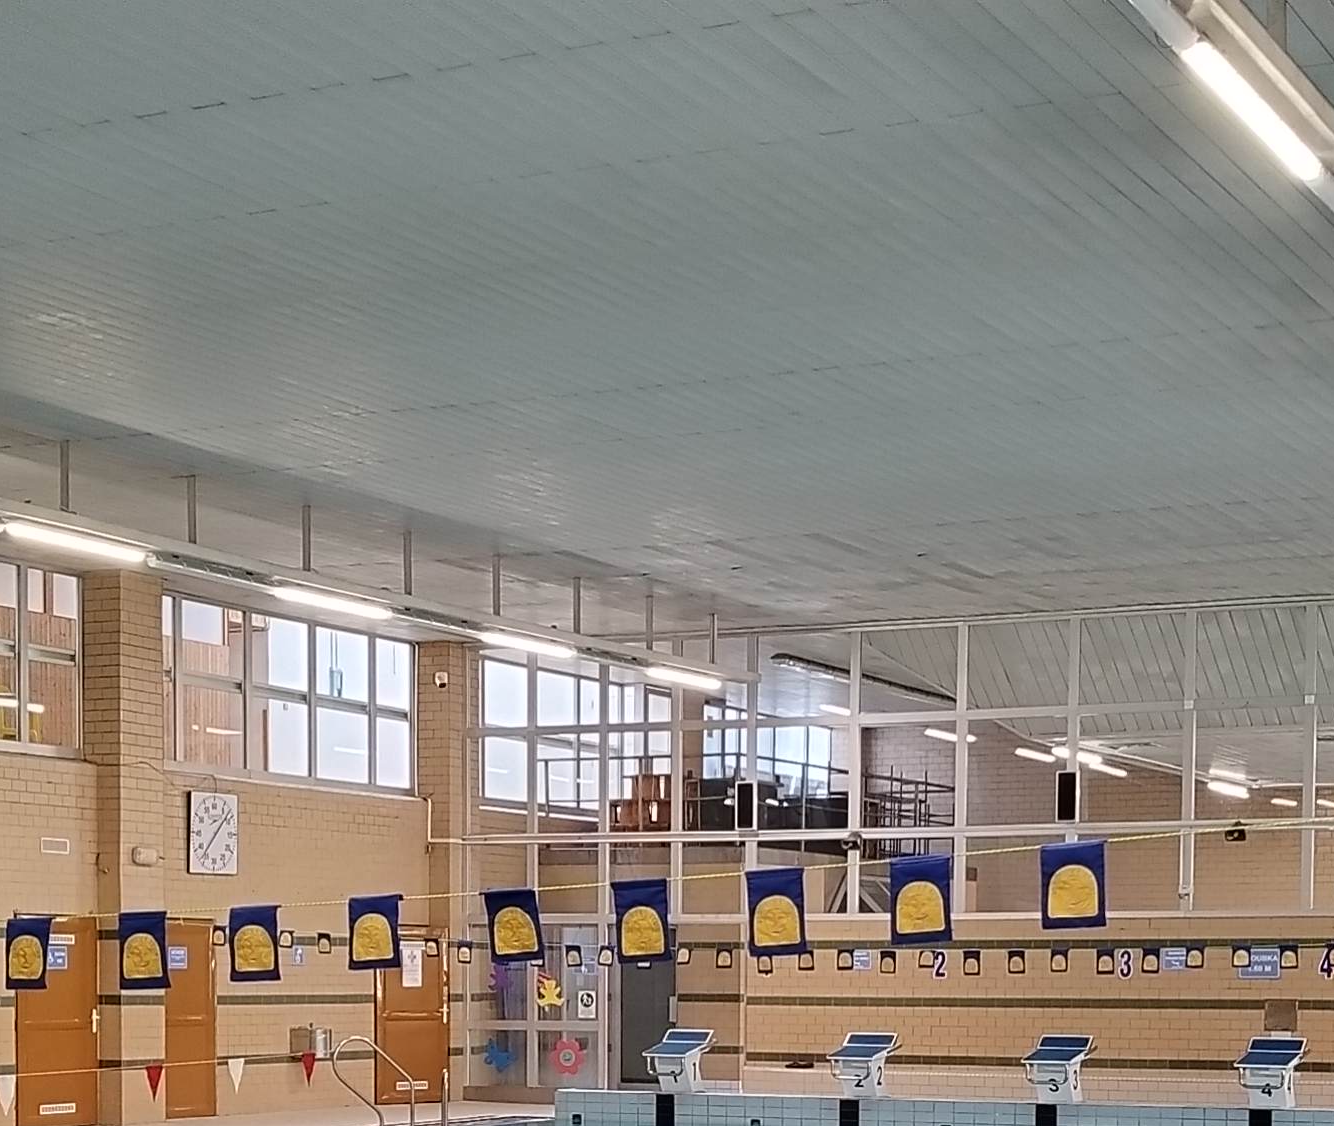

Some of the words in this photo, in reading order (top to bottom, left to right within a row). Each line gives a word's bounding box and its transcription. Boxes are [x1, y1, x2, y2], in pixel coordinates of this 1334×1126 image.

[934, 951, 946, 977] 2
[1120, 950, 1132, 978] 3
[1320, 949, 1333, 978] 4
[876, 1066, 883, 1085] 2
